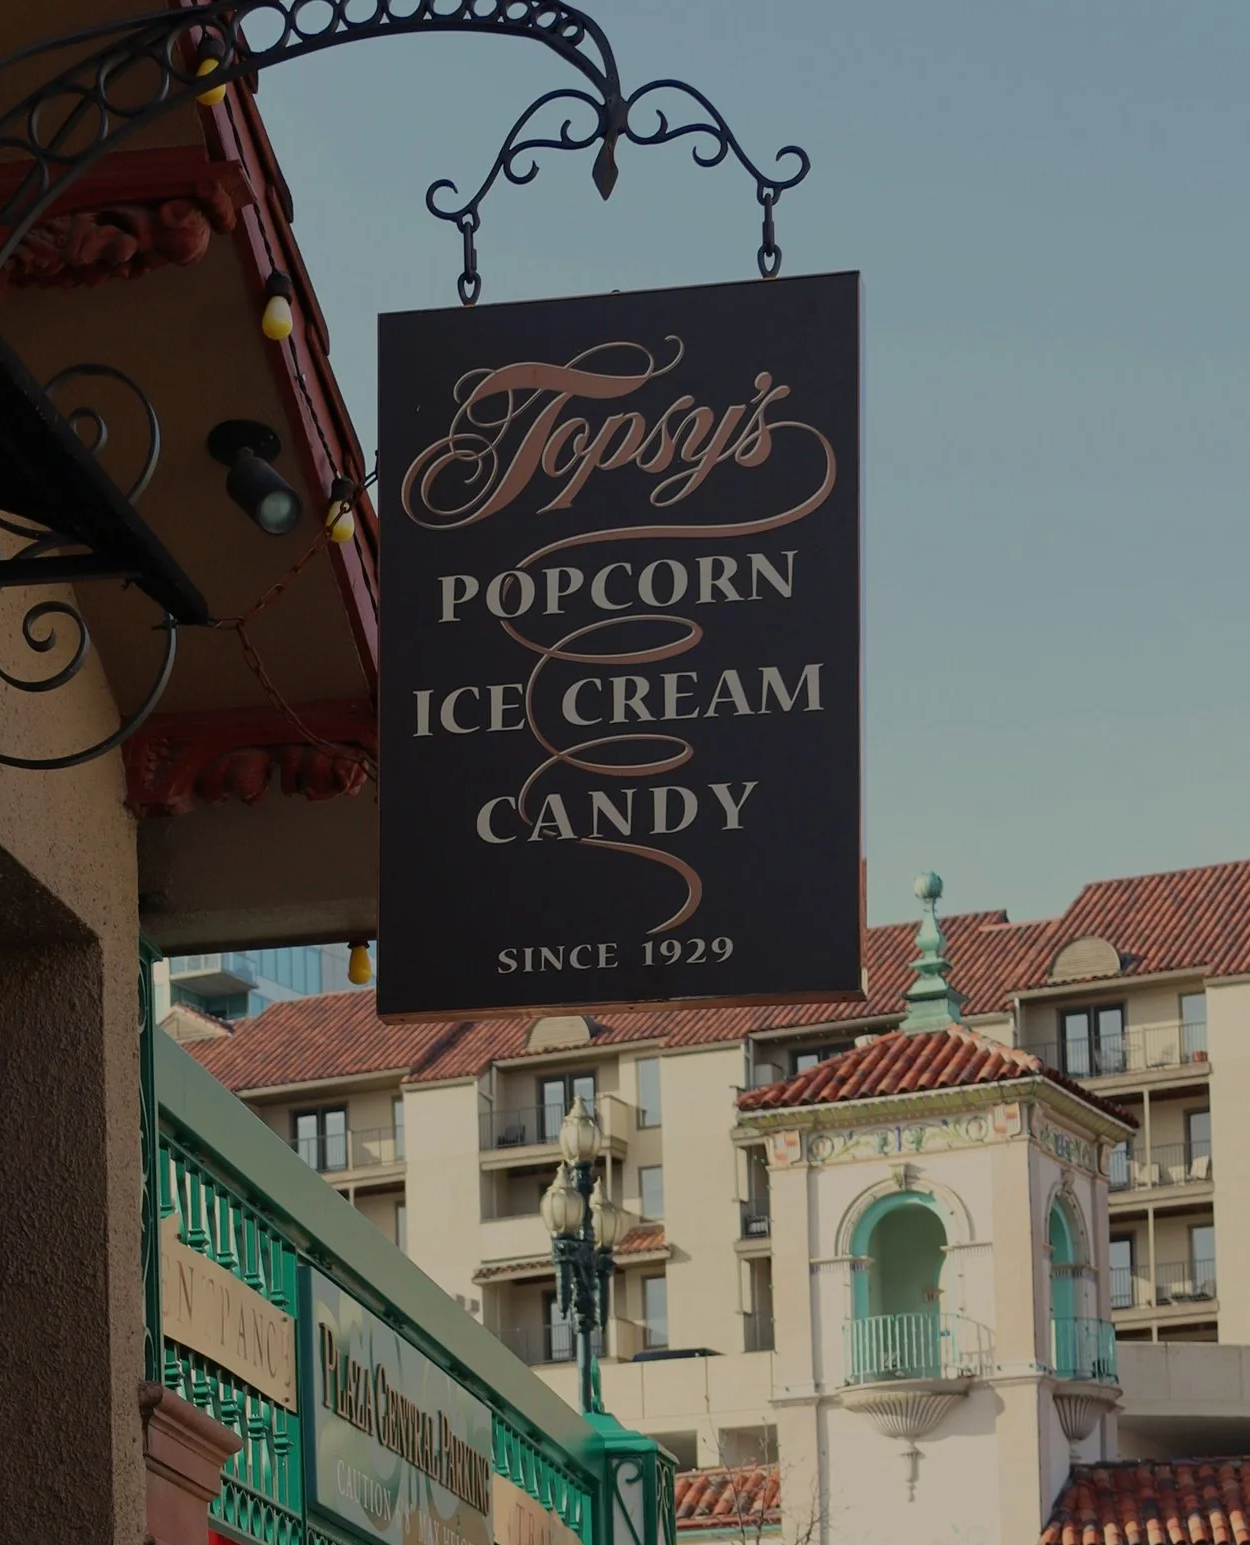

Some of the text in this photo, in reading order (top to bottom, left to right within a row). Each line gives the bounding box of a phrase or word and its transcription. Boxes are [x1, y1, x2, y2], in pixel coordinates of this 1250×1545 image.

[402, 336, 836, 530] Topsy's
[438, 551, 798, 622] POPCORN
[413, 664, 824, 737] ICE CREAM
[477, 782, 759, 843] CANDY
[498, 936, 734, 973] SINCE 1929
[319, 1322, 490, 1517] PLAZA CENTRAL PARKING
[336, 1459, 392, 1521] CAUTION
